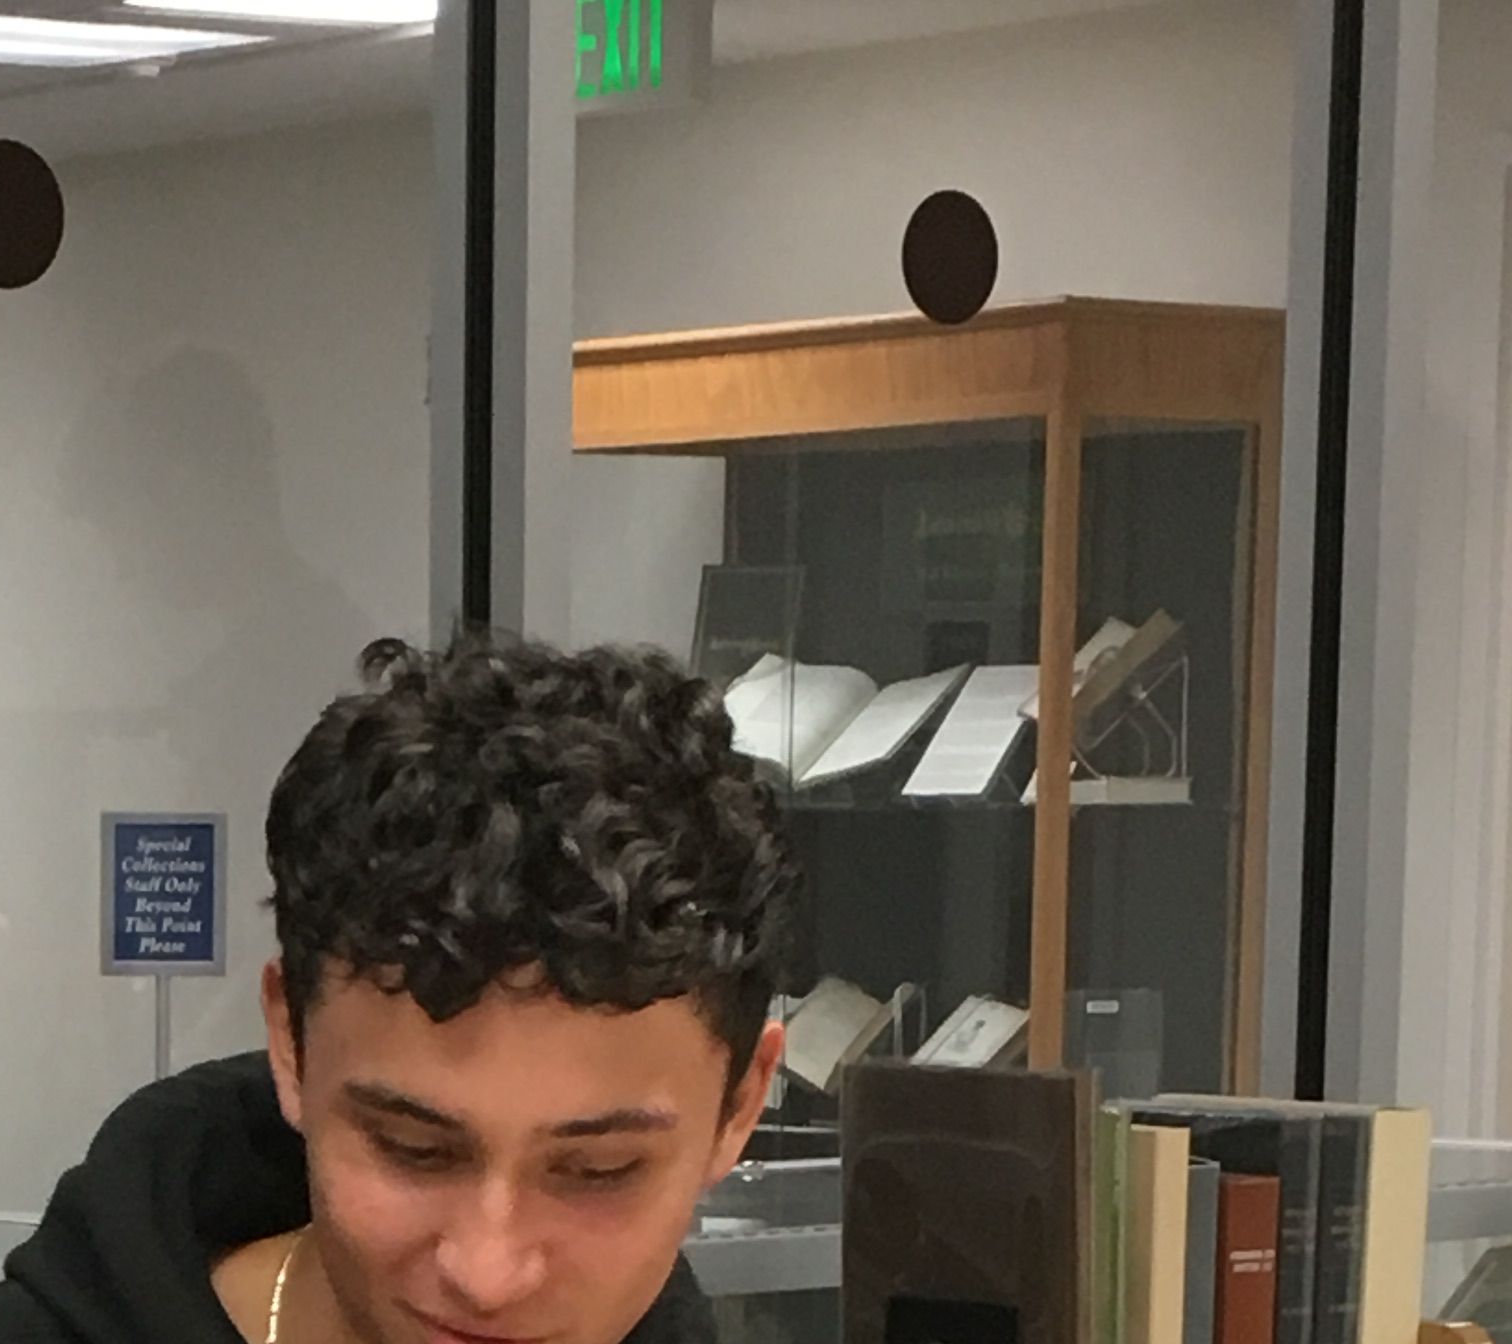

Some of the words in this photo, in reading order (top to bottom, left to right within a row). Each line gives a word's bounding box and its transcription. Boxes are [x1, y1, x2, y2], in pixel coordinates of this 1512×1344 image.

[136, 836, 191, 854] Special
[121, 856, 205, 872] Collections
[125, 876, 161, 892] Staff
[165, 876, 202, 895] Only
[135, 897, 191, 914] Beyond
[125, 916, 156, 932] This
[161, 916, 202, 932] Point
[138, 937, 186, 953] Please
